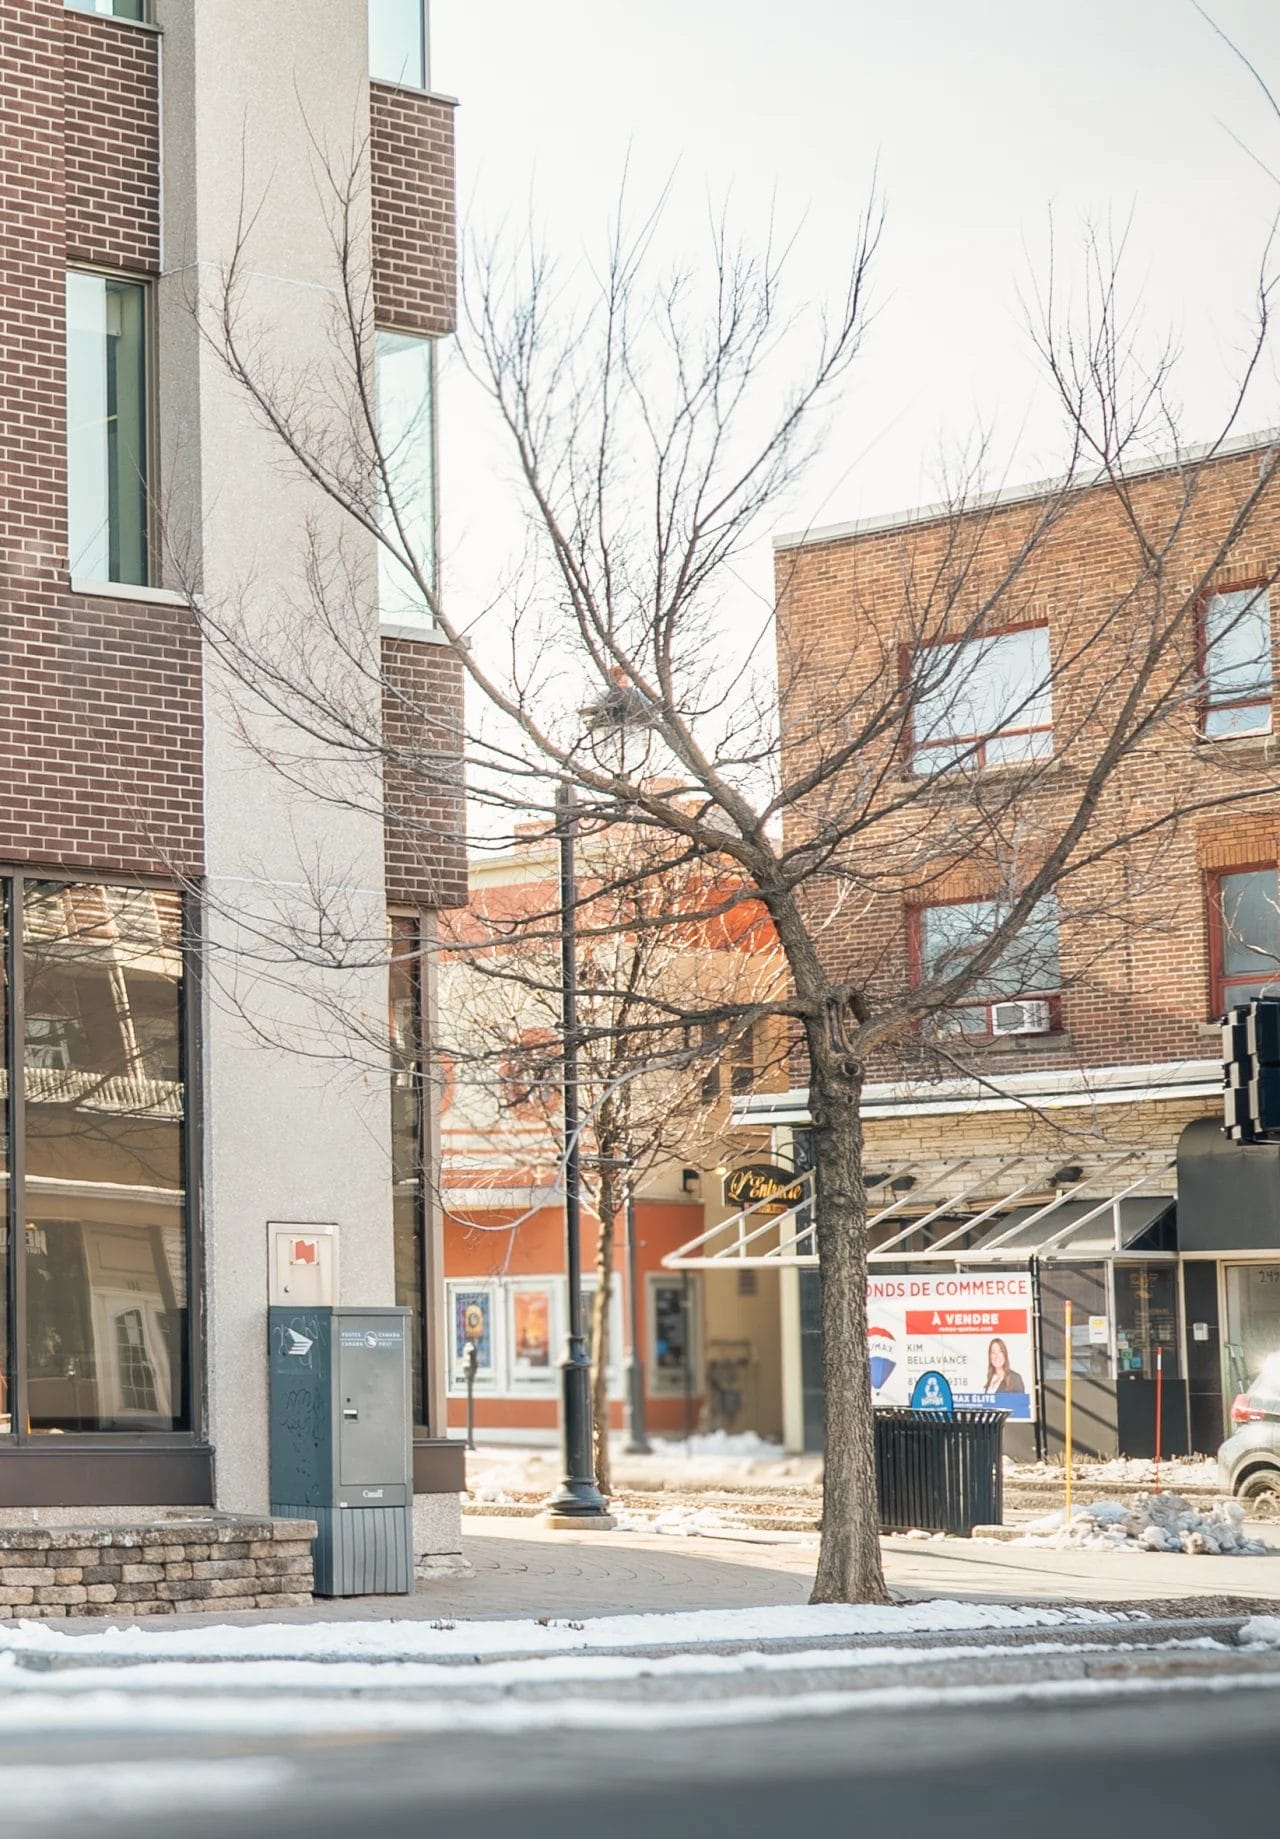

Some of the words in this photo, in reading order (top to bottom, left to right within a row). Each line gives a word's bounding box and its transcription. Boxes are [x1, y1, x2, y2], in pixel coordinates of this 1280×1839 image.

[910, 1282, 930, 1296] DE
[936, 1280, 1027, 1296] COMMERCE
[931, 1311, 941, 1325] À
[945, 1313, 999, 1325] VENDRE
[907, 1344, 923, 1352] KIM
[907, 1356, 968, 1364] BELLAVANCE
